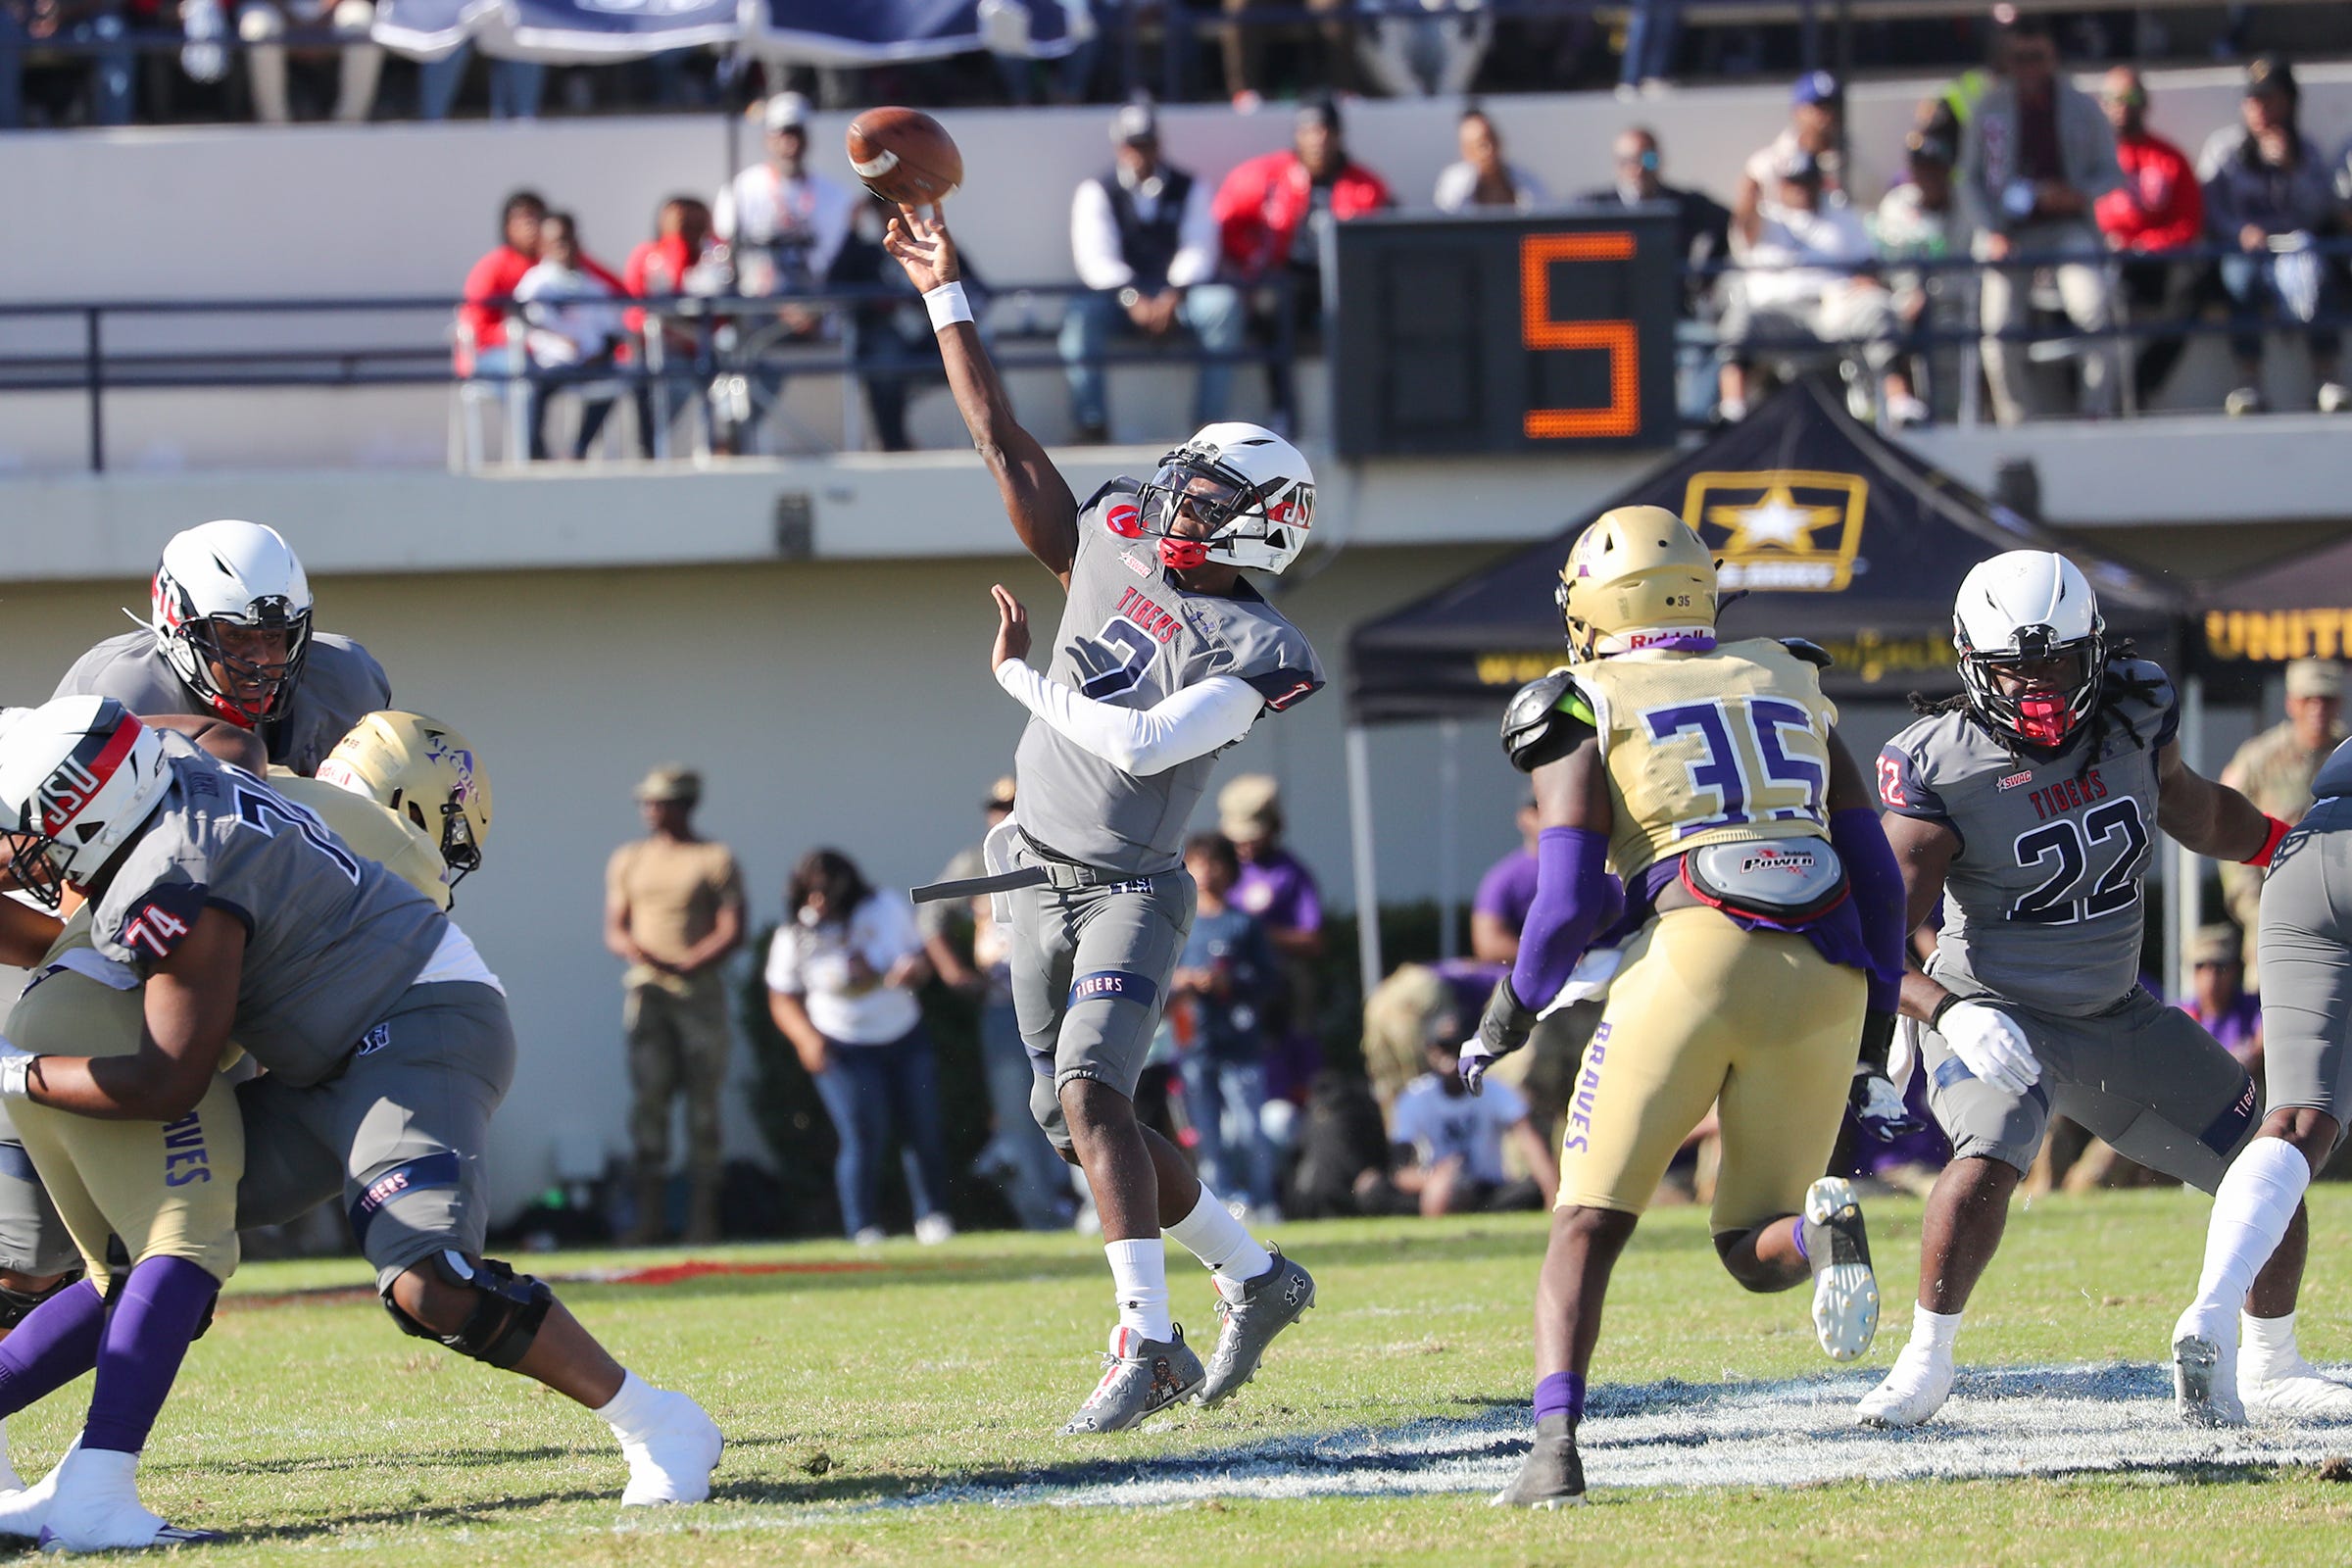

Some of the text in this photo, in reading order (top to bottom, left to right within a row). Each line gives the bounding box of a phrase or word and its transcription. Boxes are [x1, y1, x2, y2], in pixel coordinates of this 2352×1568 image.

[1521, 231, 1641, 438] 5
[1127, 556, 1151, 578] SWAC
[1116, 585, 1183, 644] TIGERS
[1677, 595, 1690, 607] 35
[1080, 615, 1160, 702] 2
[39, 754, 100, 825] JSU
[1637, 694, 1830, 843] 35
[2005, 771, 2032, 788] SWAC
[2029, 769, 2108, 820] TIGERS
[2006, 795, 2149, 925] 22
[125, 903, 191, 958] 74
[1076, 976, 1122, 999] TIGERS
[1565, 1021, 1612, 1152] BRAVES
[360, 1172, 410, 1212] TIGERS
